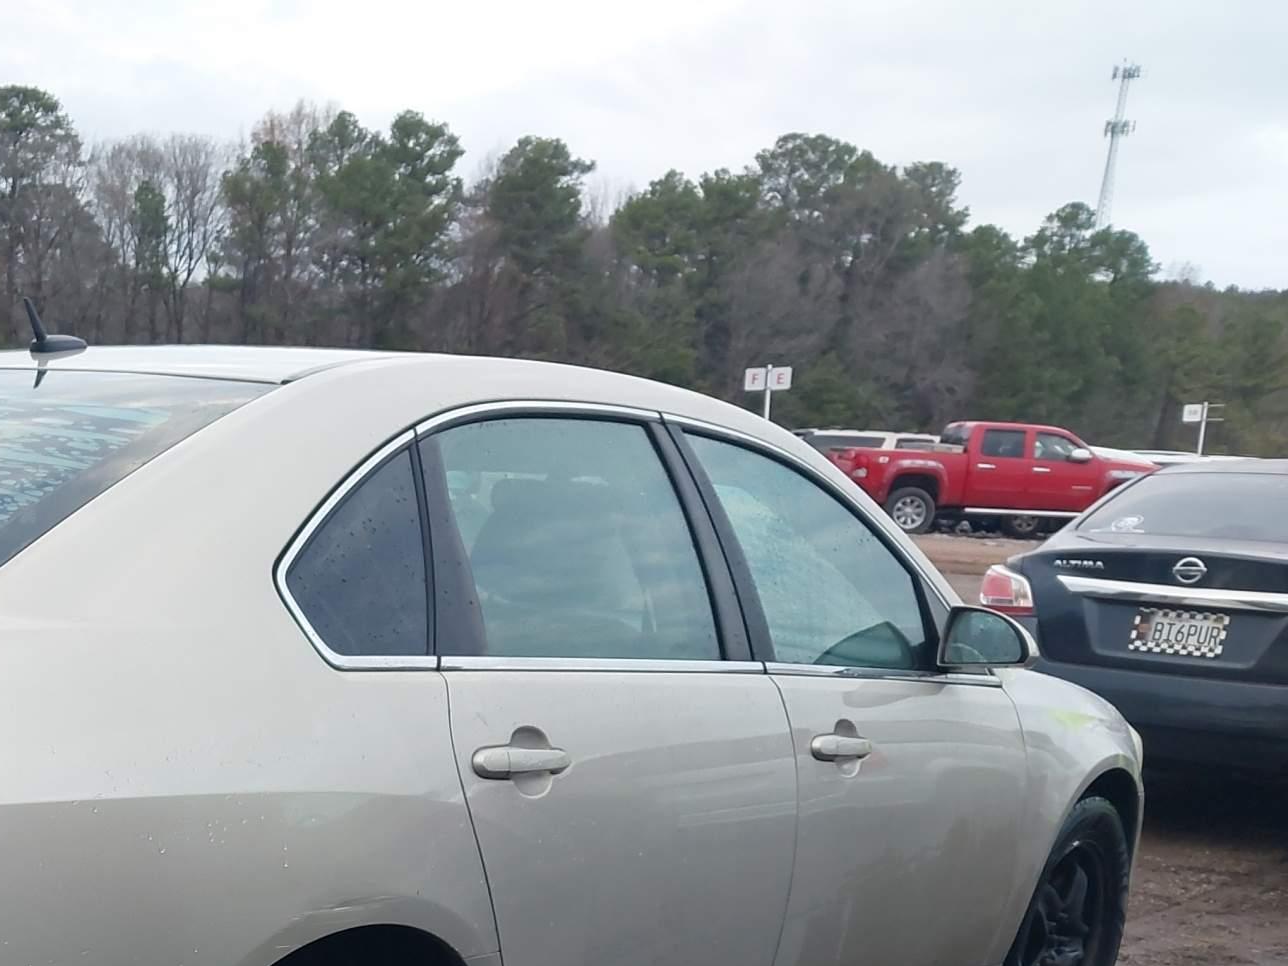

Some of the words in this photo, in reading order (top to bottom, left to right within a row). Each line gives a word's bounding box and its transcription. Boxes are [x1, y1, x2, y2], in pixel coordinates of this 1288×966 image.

[751, 373, 760, 385] F
[776, 372, 785, 385] E
[1054, 559, 1104, 569] ALTIMA
